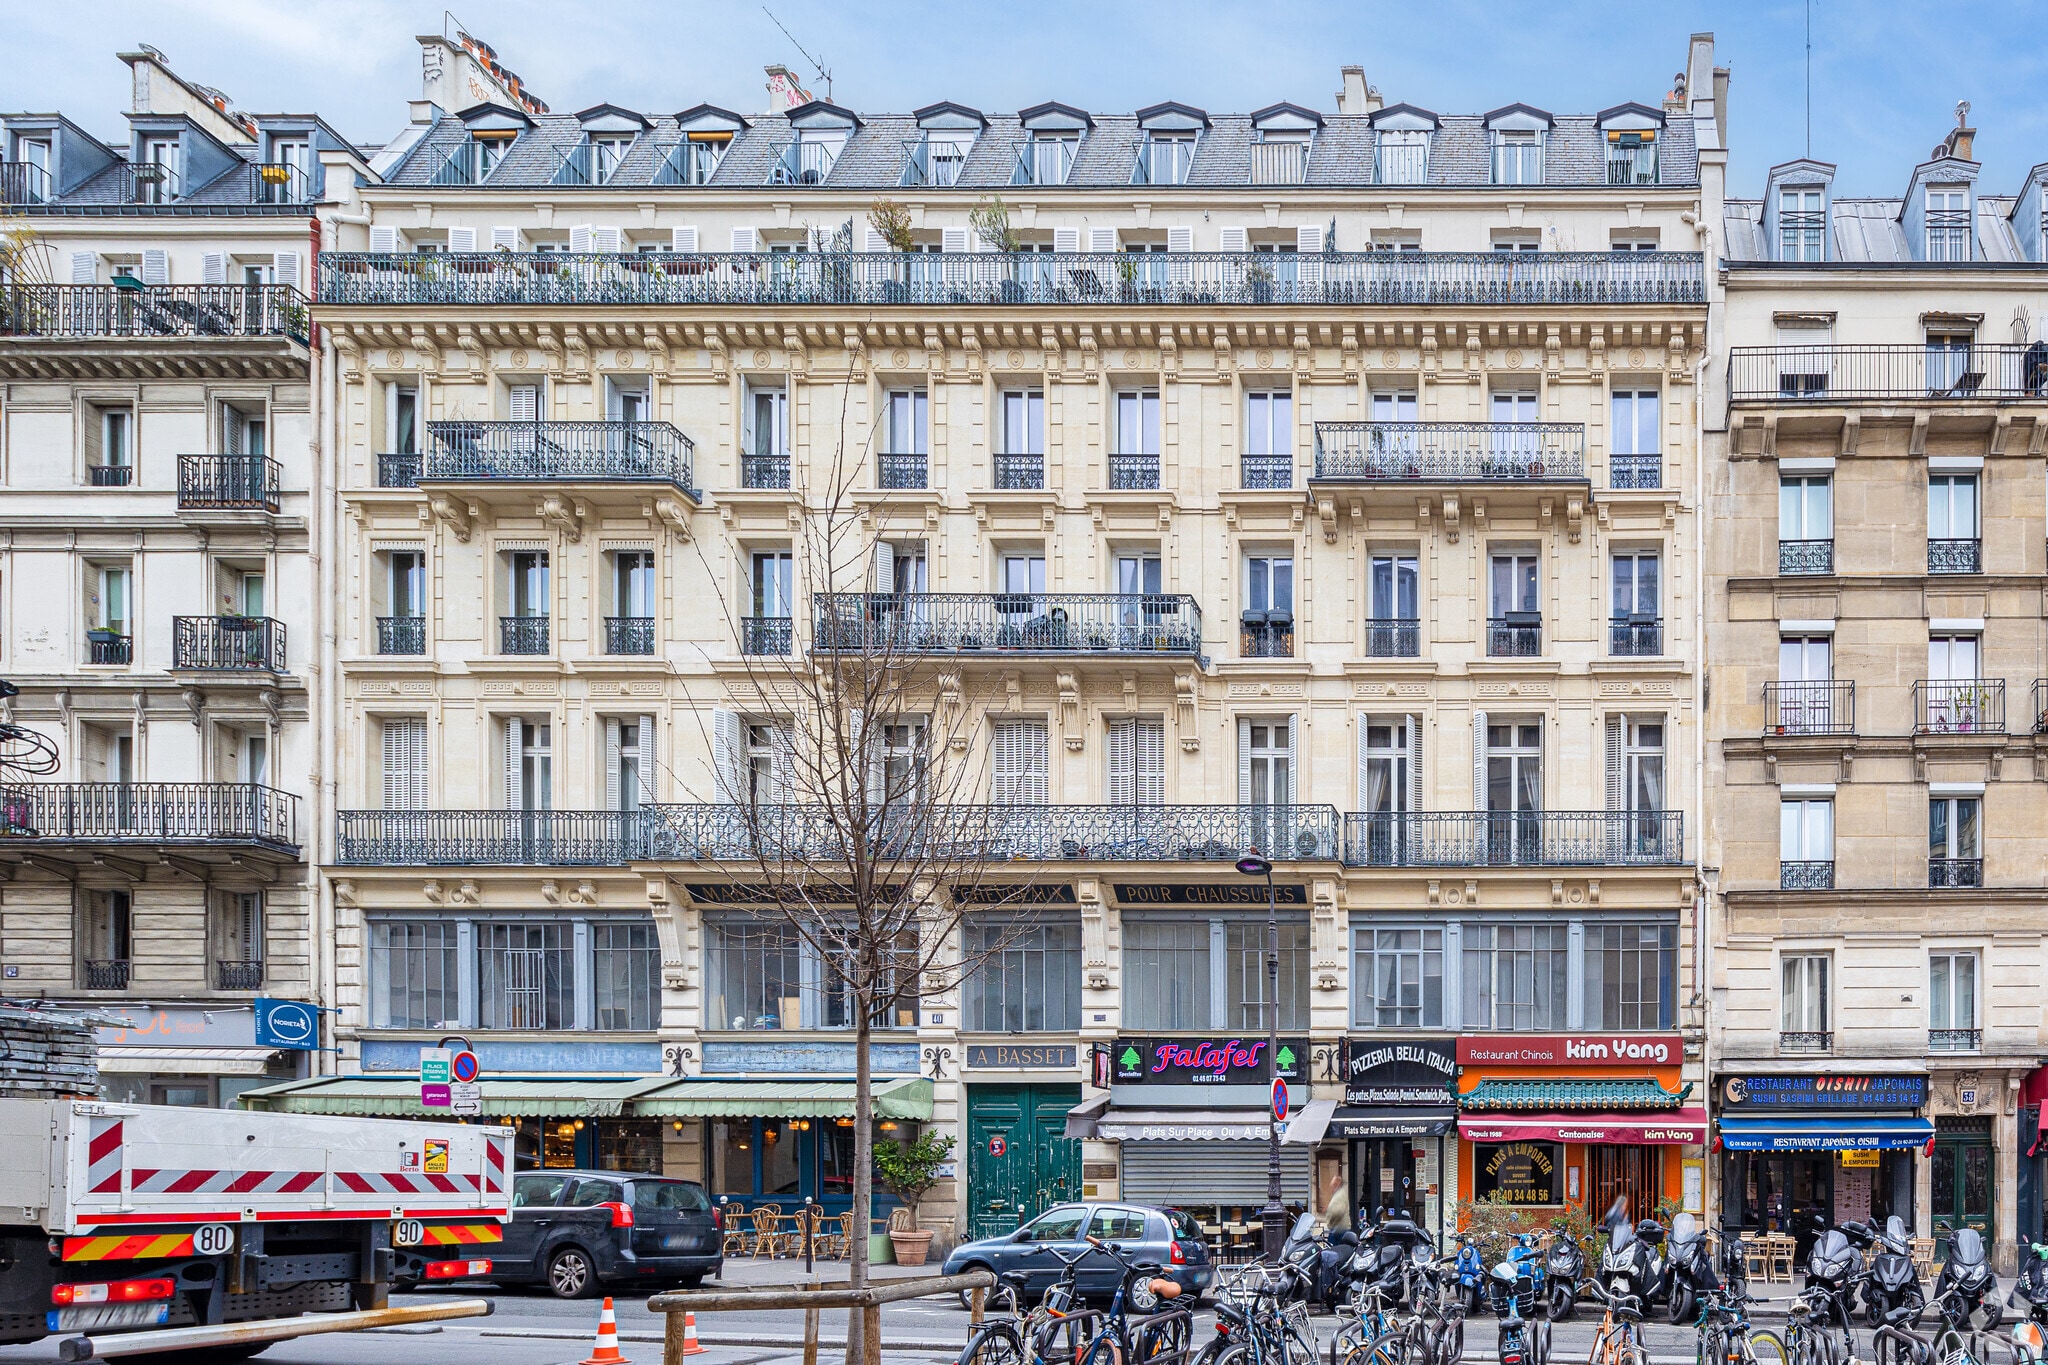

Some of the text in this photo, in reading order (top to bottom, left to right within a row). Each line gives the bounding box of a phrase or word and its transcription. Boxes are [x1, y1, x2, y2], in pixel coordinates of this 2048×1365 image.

[1126, 886, 1295, 902] POUR CHAUSSURES
[273, 1018, 300, 1028] NORIETA
[932, 1014, 942, 1024] 40
[997, 1047, 1067, 1065] BASSET
[1470, 1049, 1554, 1060] Restaurant Chinois
[1612, 1039, 1669, 1063] Yang
[1151, 1040, 1267, 1075] Falafel
[1351, 1046, 1394, 1075] PIZZERIA
[1396, 1046, 1425, 1064] BELLA
[1426, 1051, 1455, 1077] ITALIA
[1747, 1076, 1922, 1092] RESTAURANT OISHII JAPONAIS
[1752, 1093, 1777, 1103] SUSHI
[1780, 1093, 1815, 1103] SASHIMI
[1816, 1093, 1858, 1103] GRILLADE
[1863, 1093, 1873, 1103] 01
[1886, 1093, 1897, 1103] 35
[1899, 1093, 1908, 1103] 14
[1910, 1093, 1919, 1103] 12
[1963, 1091, 1974, 1102] 38
[1142, 1127, 1166, 1137] Plats
[1168, 1127, 1185, 1137] Sur
[1187, 1127, 1213, 1137] Place
[1221, 1127, 1235, 1137] Ou
[1244, 1127, 1251, 1136] A
[1344, 1126, 1359, 1135] Plats
[1359, 1126, 1369, 1135] Sur
[1370, 1126, 1386, 1135] Place
[1394, 1126, 1400, 1134] A
[1401, 1126, 1428, 1135] Emporter
[1467, 1130, 1489, 1138] Depuis
[1558, 1129, 1605, 1139] Cantonaises
[1666, 1130, 1694, 1141] Yang
[1821, 1138, 1856, 1147] JAPONAIS
[1857, 1137, 1879, 1146] OISHII
[1485, 1149, 1507, 1176] PLATS
[1515, 1143, 1553, 1175] EMPORTER
[1503, 1189, 1513, 1201] 40
[1514, 1189, 1524, 1201] 34
[1526, 1189, 1536, 1201] 48
[1538, 1189, 1549, 1201] 56
[400, 1221, 419, 1243] 90
[201, 1226, 227, 1251] 80
